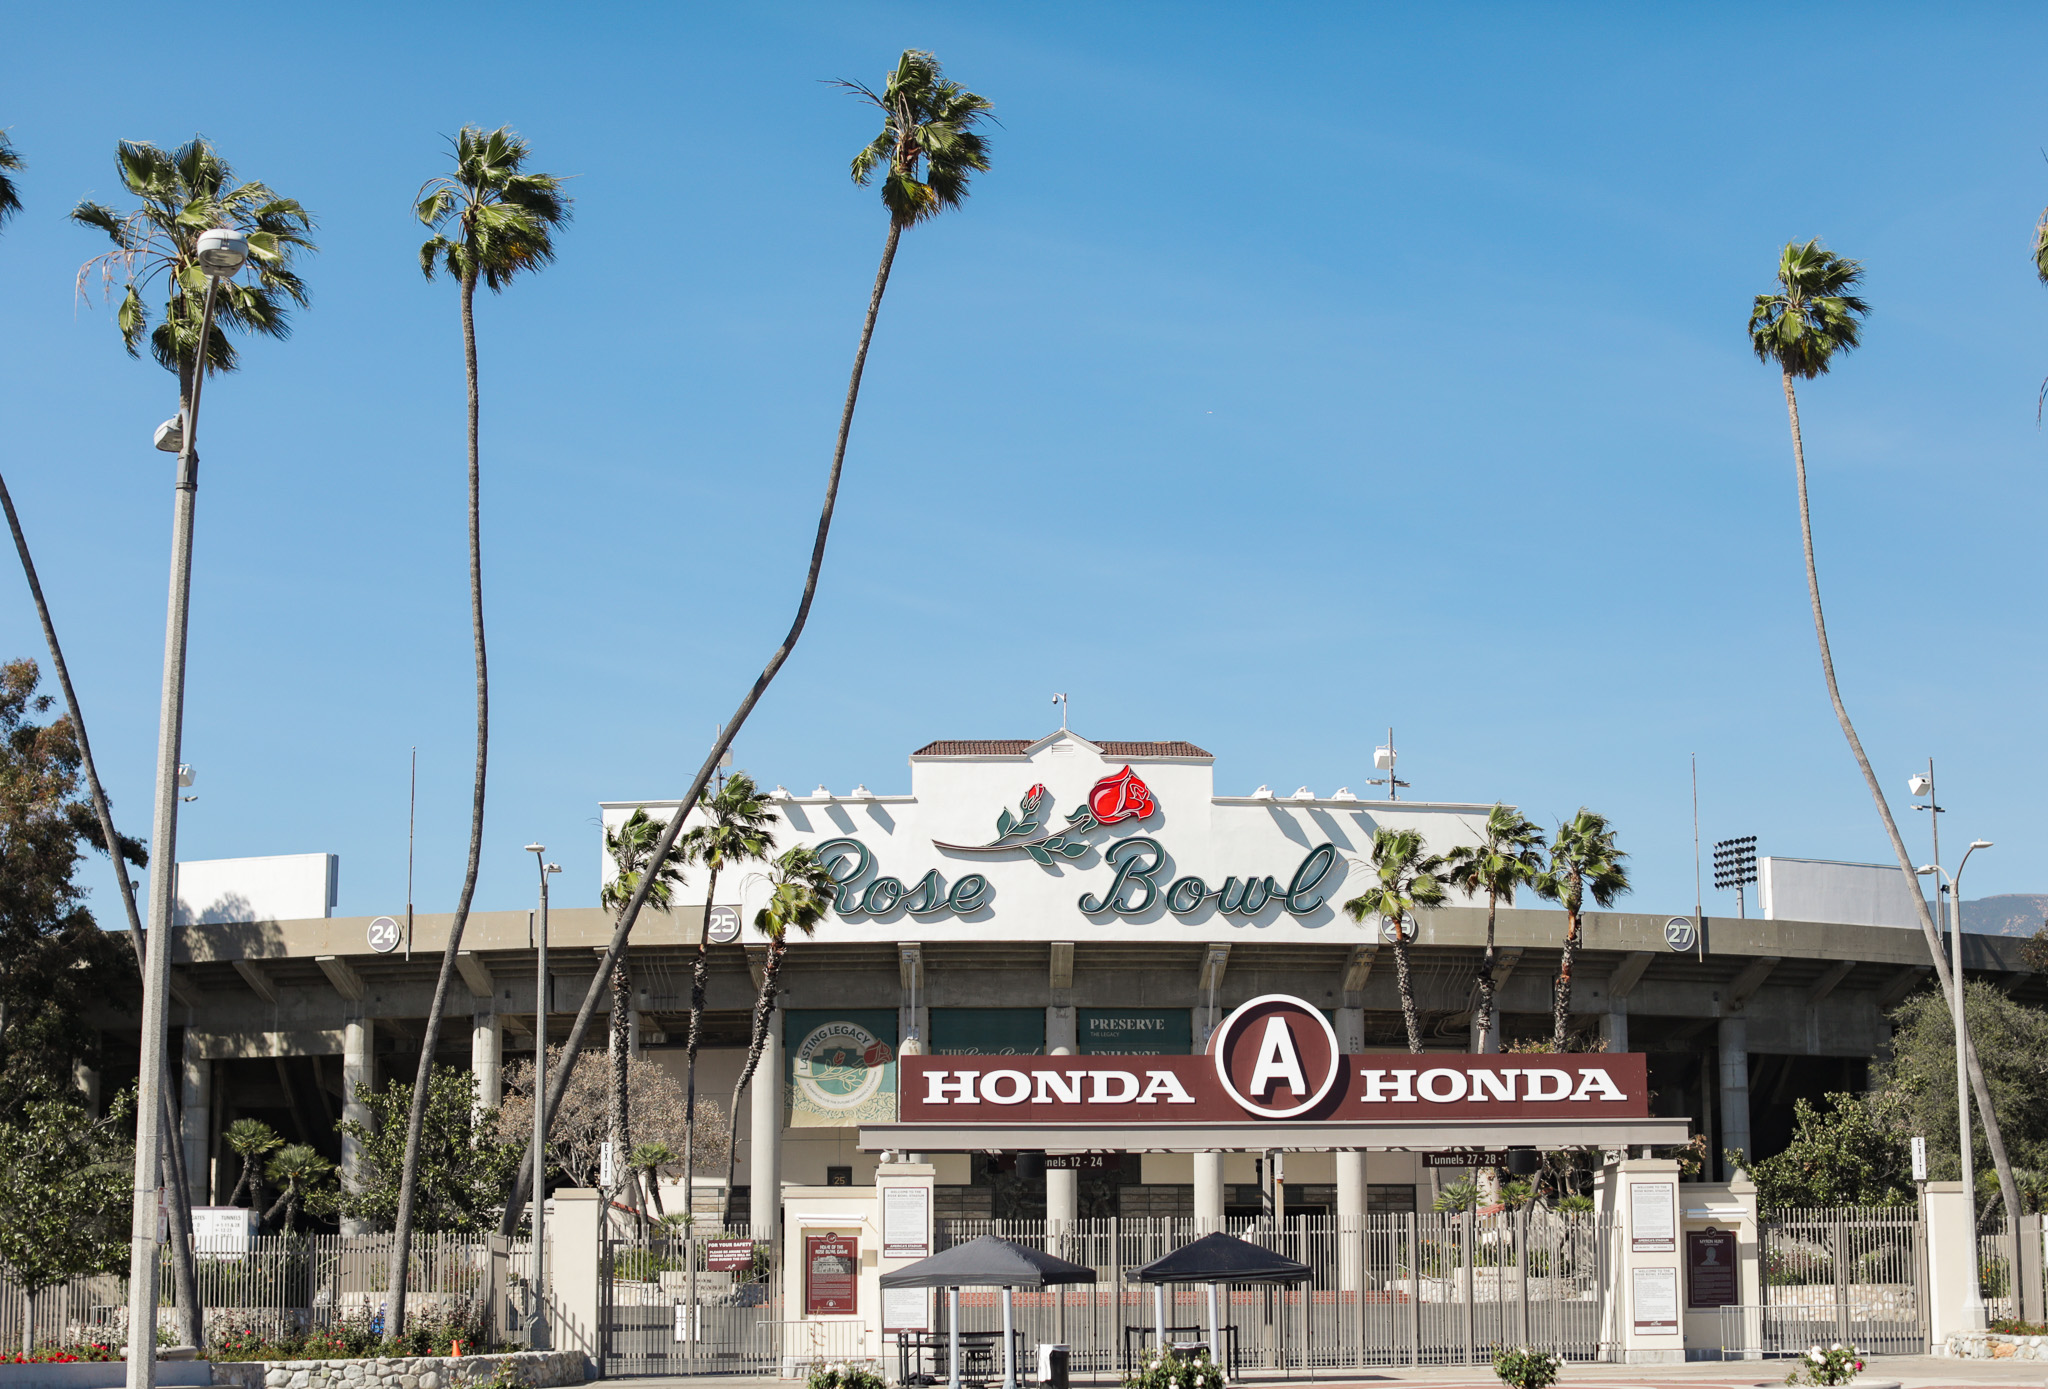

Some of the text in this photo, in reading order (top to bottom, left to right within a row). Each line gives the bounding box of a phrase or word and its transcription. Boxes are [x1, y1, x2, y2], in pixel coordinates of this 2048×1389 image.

[811, 836, 1337, 916] Rose Bowl
[708, 914, 736, 934] 25
[1668, 924, 1692, 944] 27
[371, 925, 396, 944] 24
[1090, 1018, 1165, 1030] PRESERVE
[800, 1026, 870, 1070] LASTING LEGACY
[1249, 1016, 1306, 1095] A
[922, 1069, 1196, 1104] HONDA
[1360, 1068, 1627, 1102] HONDA
[1070, 1157, 1080, 1167] 12
[1090, 1157, 1103, 1167] 24
[1428, 1154, 1464, 1165] Tunnels
[1467, 1154, 1478, 1165] 27
[1484, 1154, 1496, 1165] 28
[834, 1176, 846, 1185] 25
